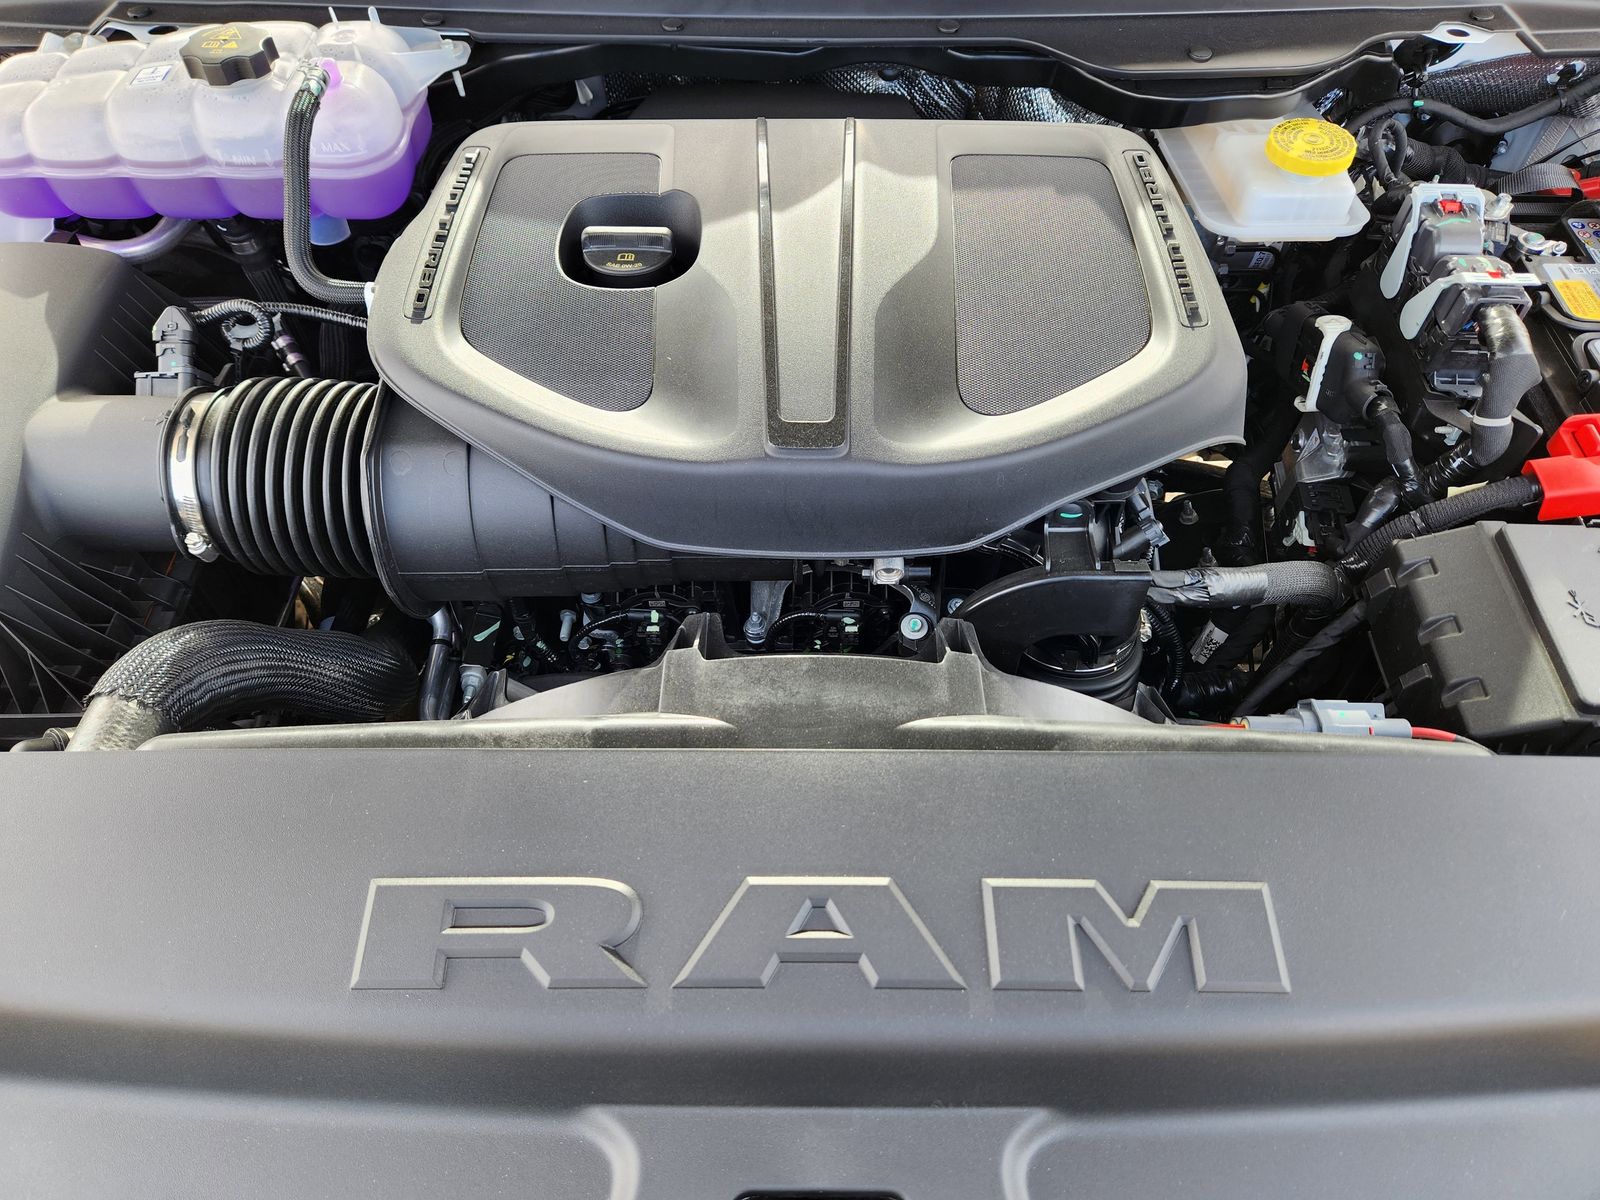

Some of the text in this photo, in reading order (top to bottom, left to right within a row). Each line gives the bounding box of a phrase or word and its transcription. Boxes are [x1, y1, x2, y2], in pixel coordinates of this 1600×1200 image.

[413, 148, 480, 309] TWIN TURBO
[1133, 151, 1199, 318] TWIN TURBO
[350, 875, 1292, 994] RAM
